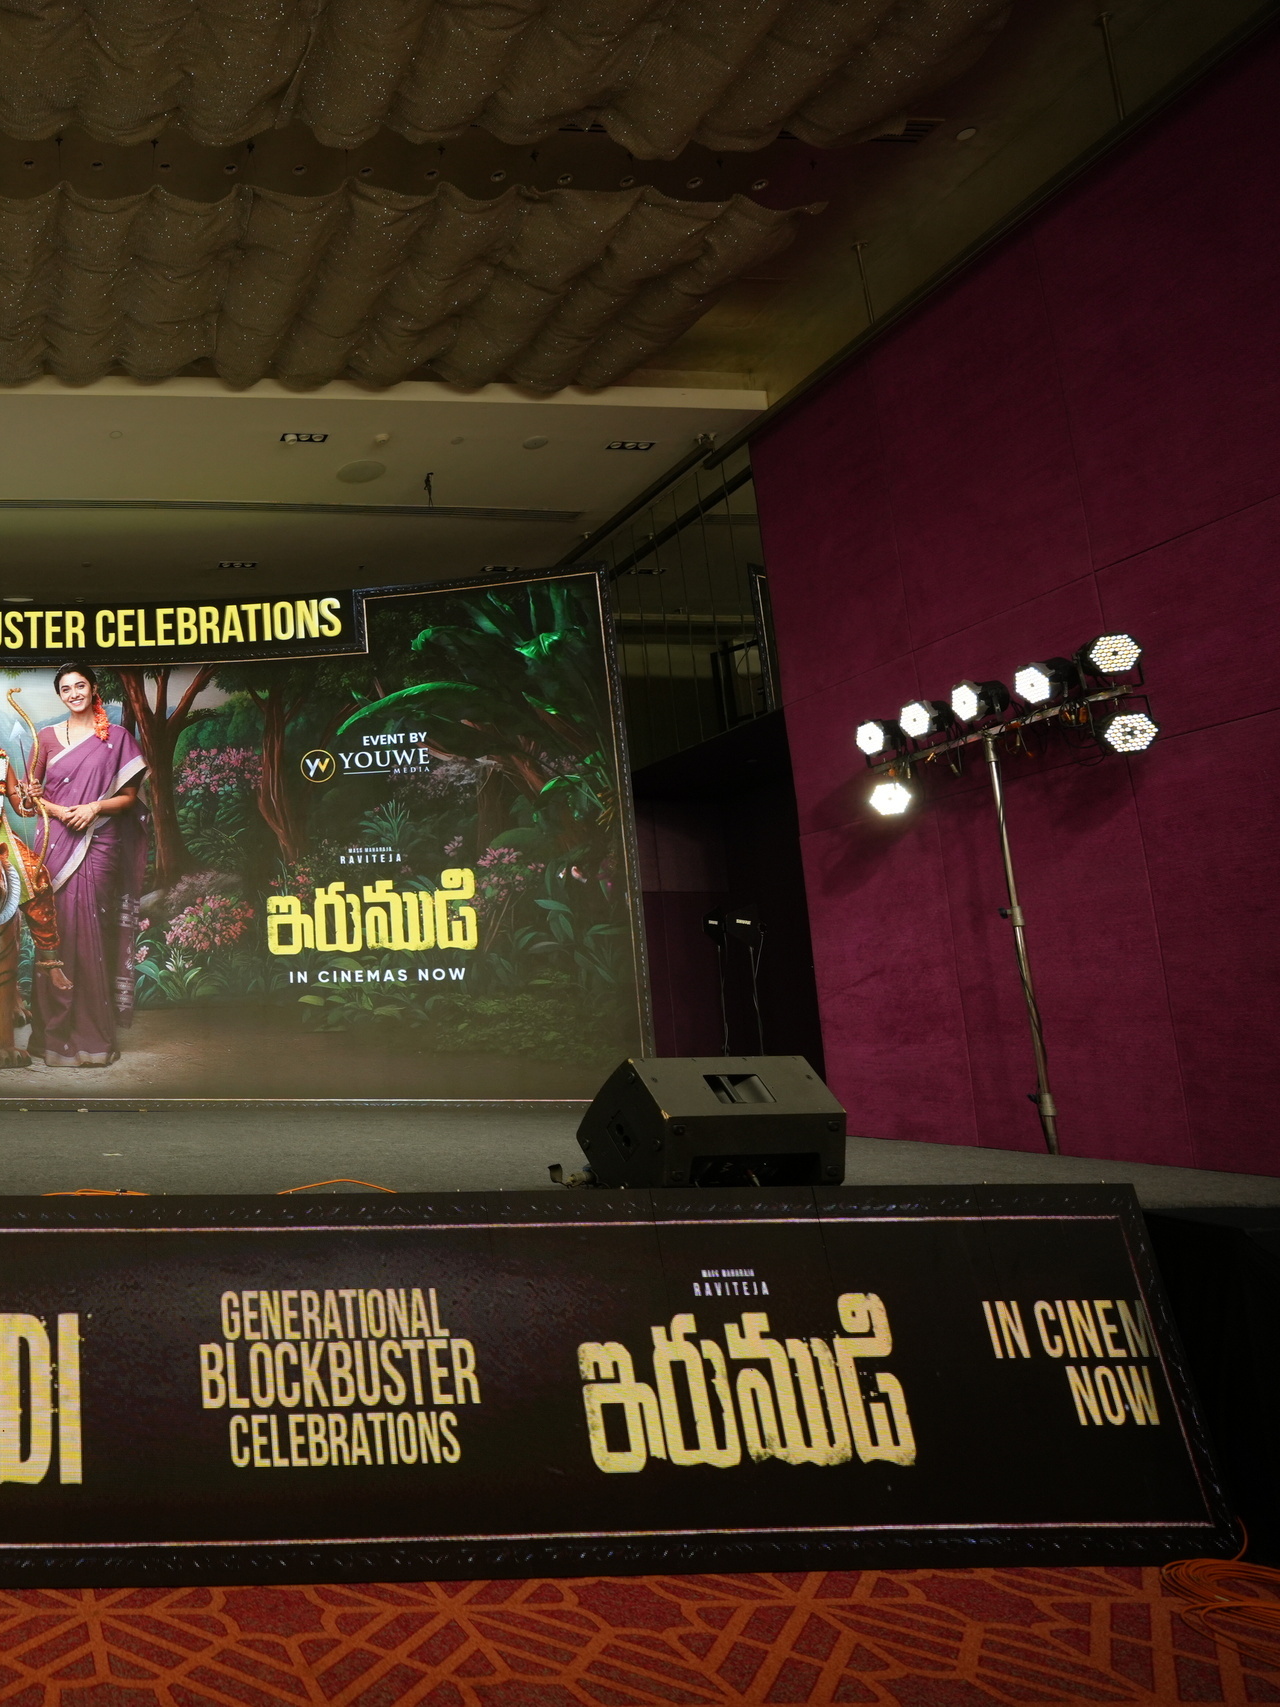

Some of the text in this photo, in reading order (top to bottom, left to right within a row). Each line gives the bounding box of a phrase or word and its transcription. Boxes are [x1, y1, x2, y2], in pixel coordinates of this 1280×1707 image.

[95, 597, 342, 648] CELEBRATIONS
[363, 732, 427, 746] EVENT BY
[339, 747, 430, 769] YOUWE
[394, 766, 430, 775] MEDIA
[340, 853, 401, 864] RAVITEJA
[289, 967, 466, 984] IN CINEMAS NOW
[693, 1281, 769, 1297] RAVITEJA
[220, 1287, 450, 1341] GENERATIONAL
[982, 1299, 1158, 1359] IN CINEM
[199, 1338, 482, 1409] BLOCKBUSTER
[1065, 1365, 1160, 1426] NOW
[229, 1411, 462, 1468] CELEBRATIONS
